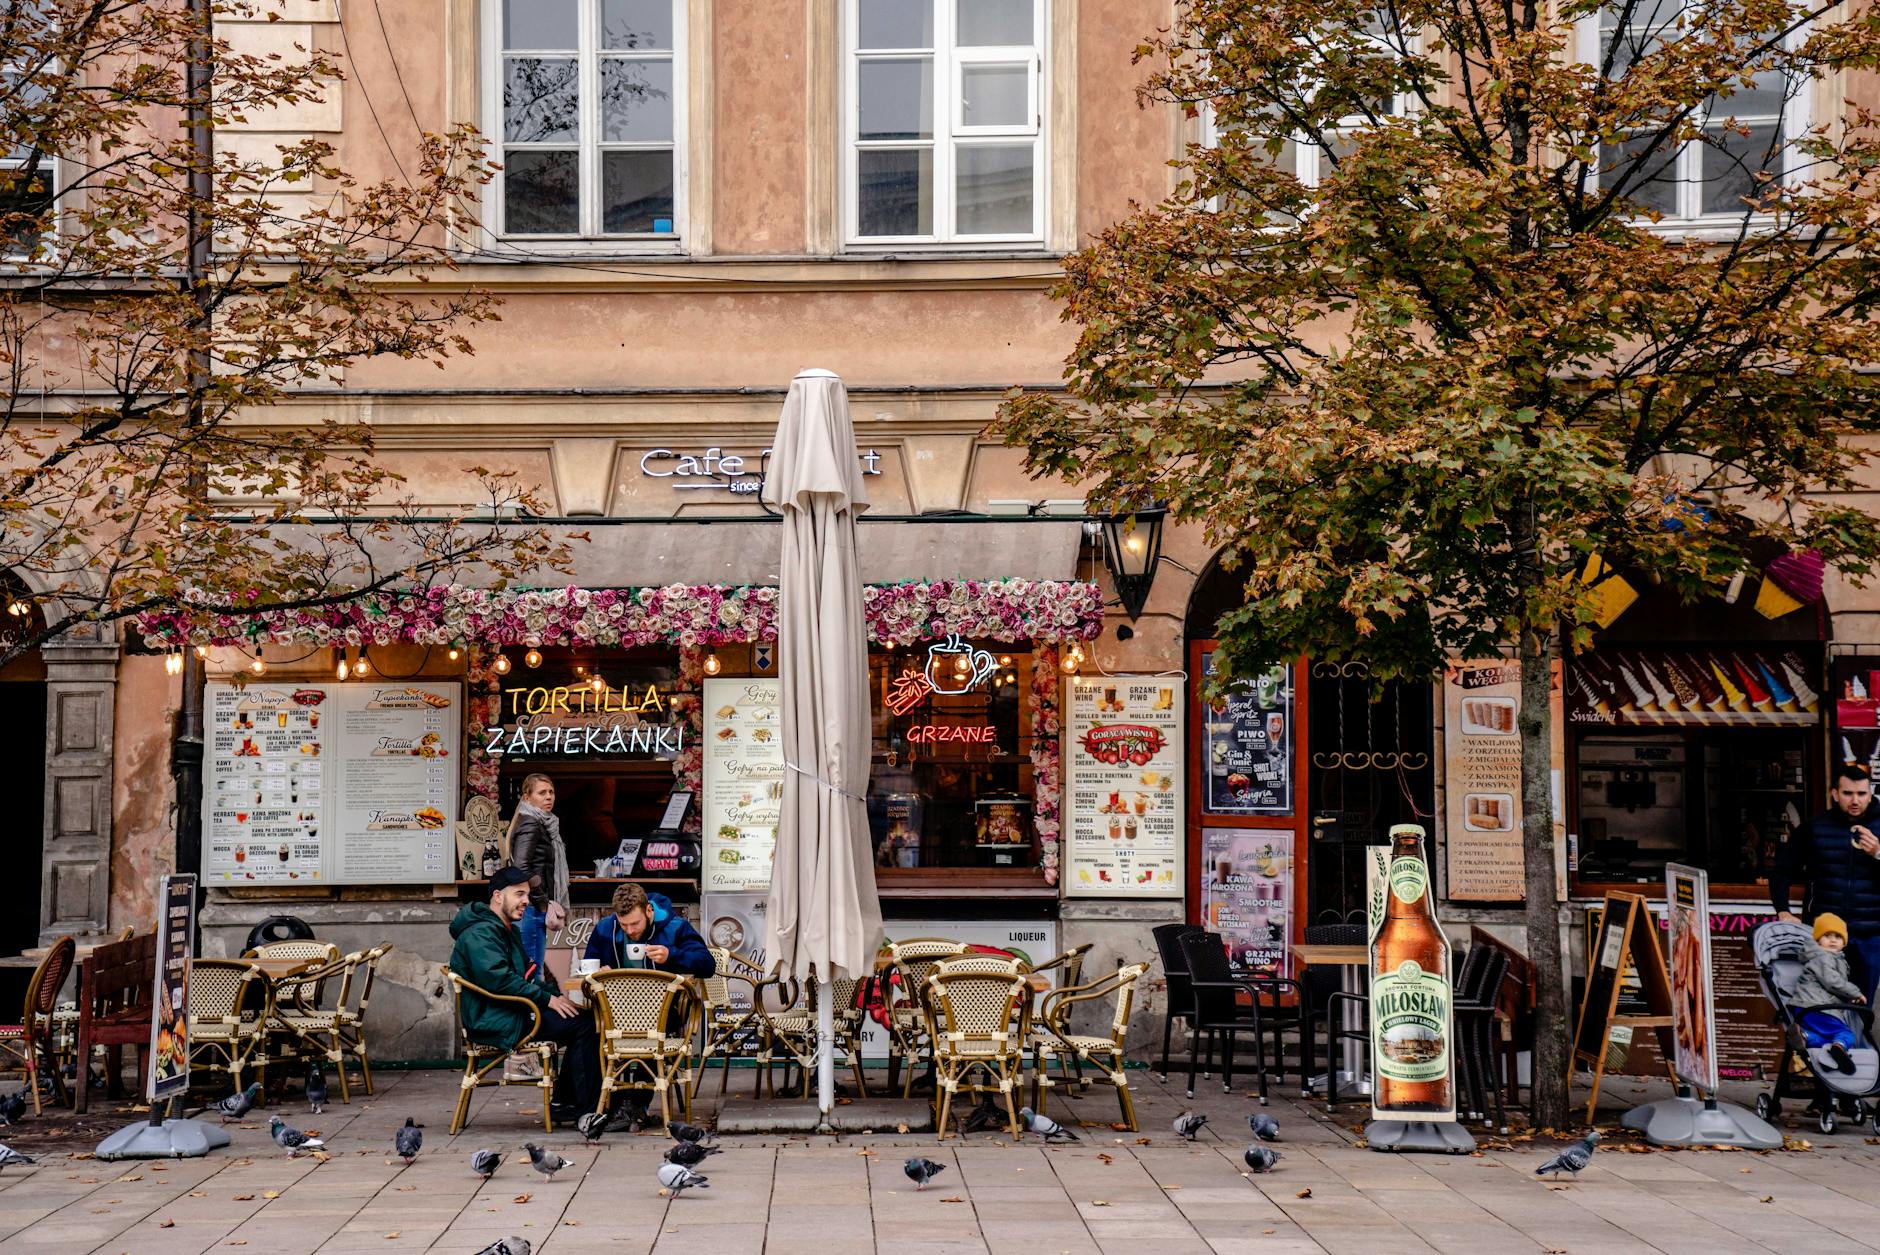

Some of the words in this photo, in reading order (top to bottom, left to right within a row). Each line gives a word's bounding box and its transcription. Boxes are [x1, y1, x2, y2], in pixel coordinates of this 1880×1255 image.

[641, 448, 746, 477] Cafe
[730, 481, 759, 492] since
[250, 692, 287, 705] Napoje
[372, 690, 422, 702] Zapiekanki
[505, 685, 663, 715] TORTILLA
[744, 685, 776, 701] Gofry
[1231, 708, 1258, 723] Spritz
[1570, 707, 1616, 722] Świderki
[486, 725, 683, 754] ZAPIEKANKI
[906, 725, 996, 743] GRZANE
[1123, 728, 1153, 738] WIŚNIA
[379, 736, 412, 749] Tortilla
[724, 760, 753, 774] Gofry
[1253, 763, 1269, 772] SHOT
[1236, 790, 1272, 804] Sangria
[368, 810, 414, 824] Kanapki
[725, 808, 753, 822] Gofry
[646, 842, 679, 857] WINO
[1009, 932, 1046, 941] LIQUEUR
[1376, 992, 1446, 1022] MIŁOSŁAW
[1385, 1016, 1418, 1028] CHMIELOWY
[1419, 1017, 1437, 1028] LAGER
